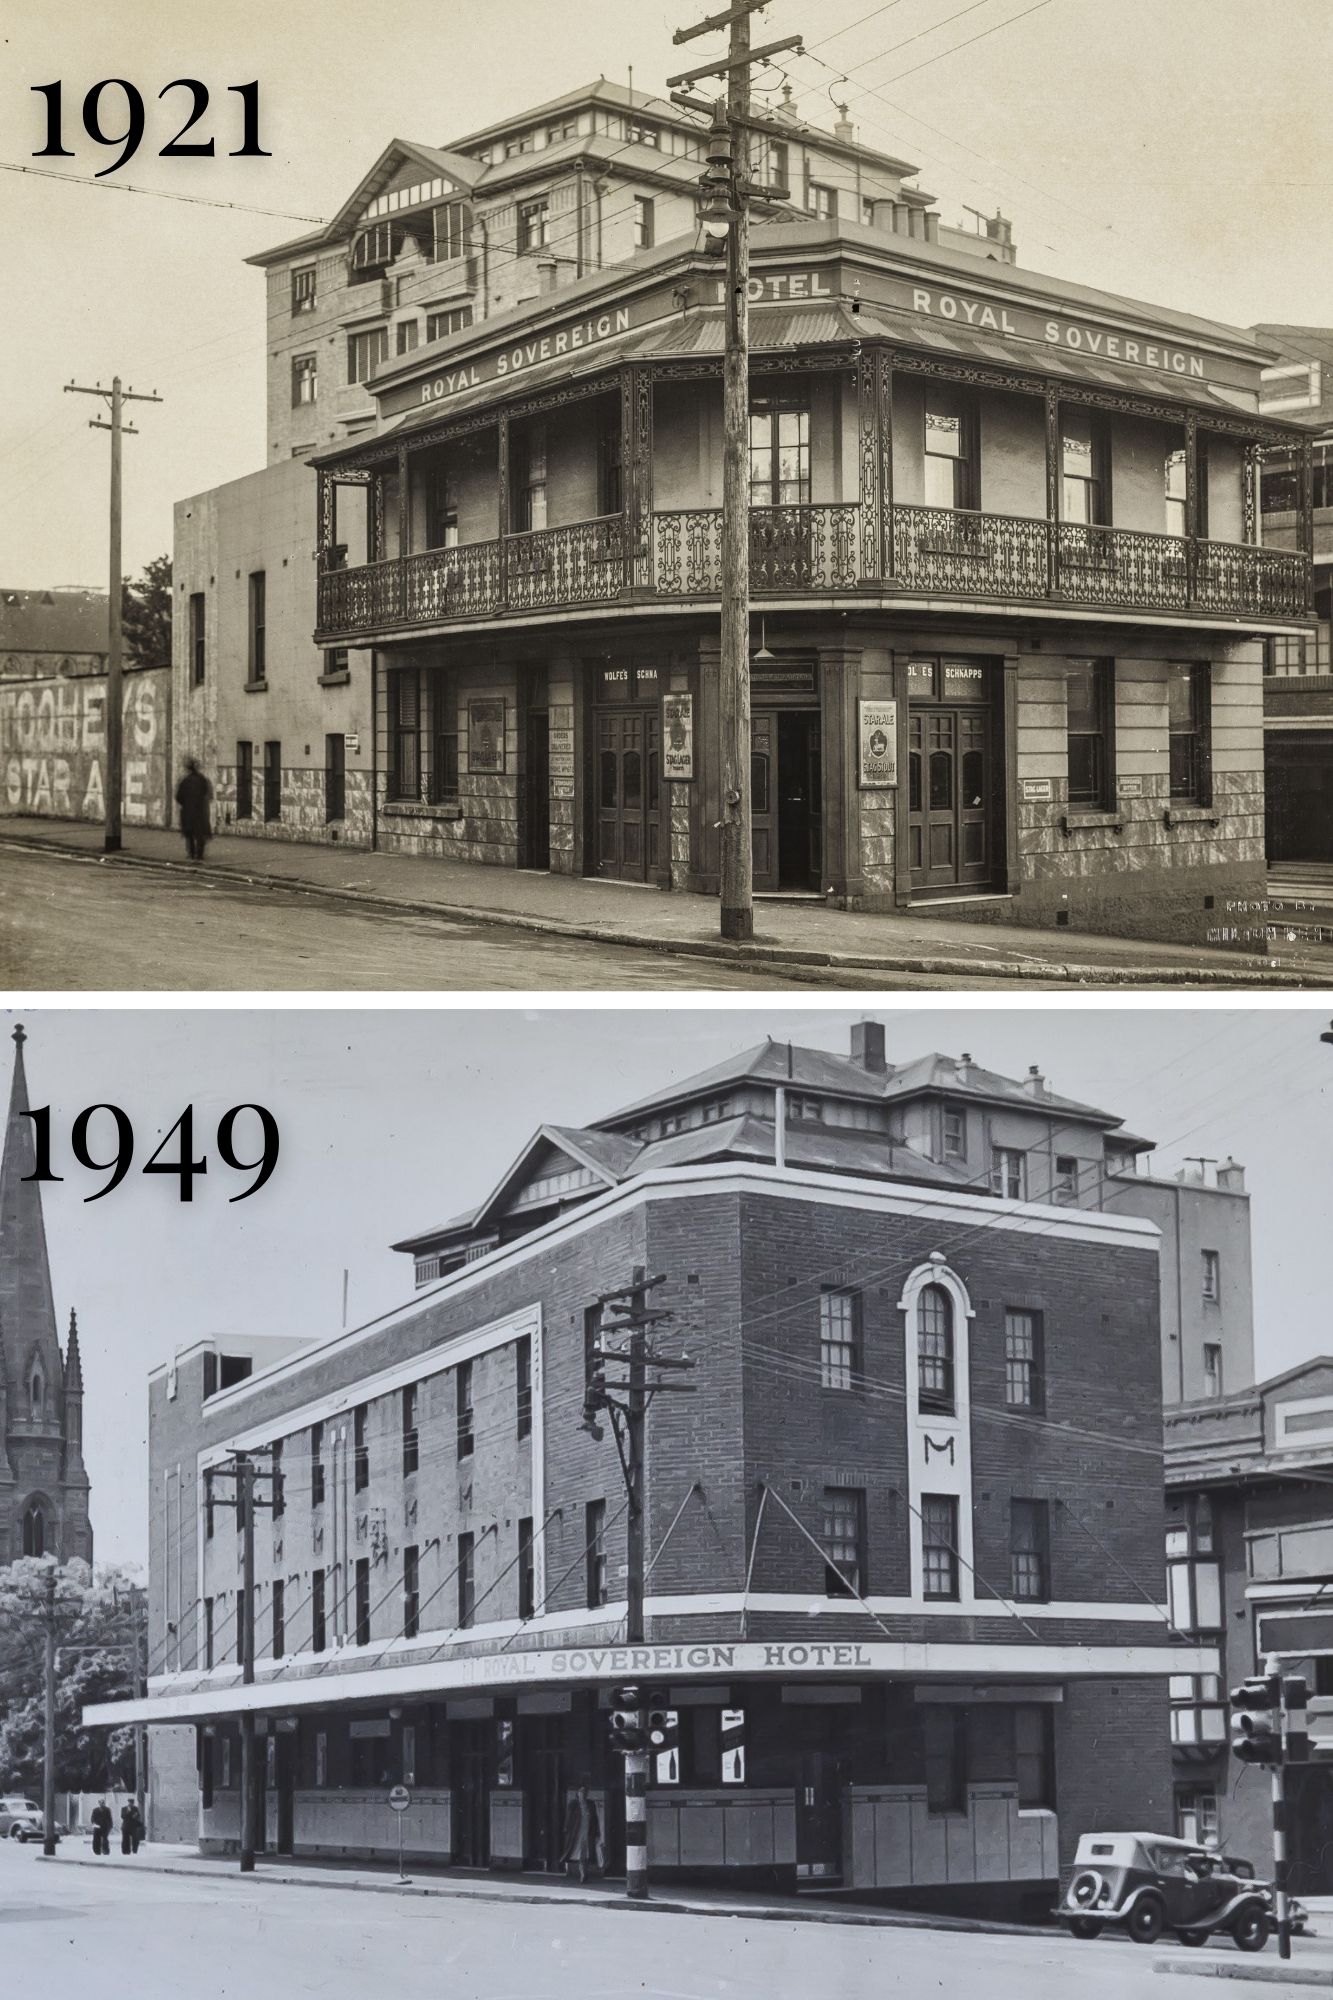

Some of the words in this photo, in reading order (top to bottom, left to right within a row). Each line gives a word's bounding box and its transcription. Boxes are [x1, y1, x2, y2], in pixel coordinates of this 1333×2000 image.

[913, 288, 1015, 334] ROYAL
[1045, 322, 1205, 377] SOVEREIGN
[421, 364, 481, 403] ROYAL
[497, 307, 630, 376] SOVEREIGN
[945, 667, 983, 679] SCHNAPPS
[863, 714, 881, 725] STAR
[881, 713, 895, 725] ALE
[877, 762, 895, 773] STOUT
[5, 757, 71, 813] STAR
[82, 759, 148, 821] AE
[484, 1656, 536, 1678] ROYAL
[551, 1647, 736, 1673] SOVEREIGN
[764, 1645, 872, 1667] HOTEL
